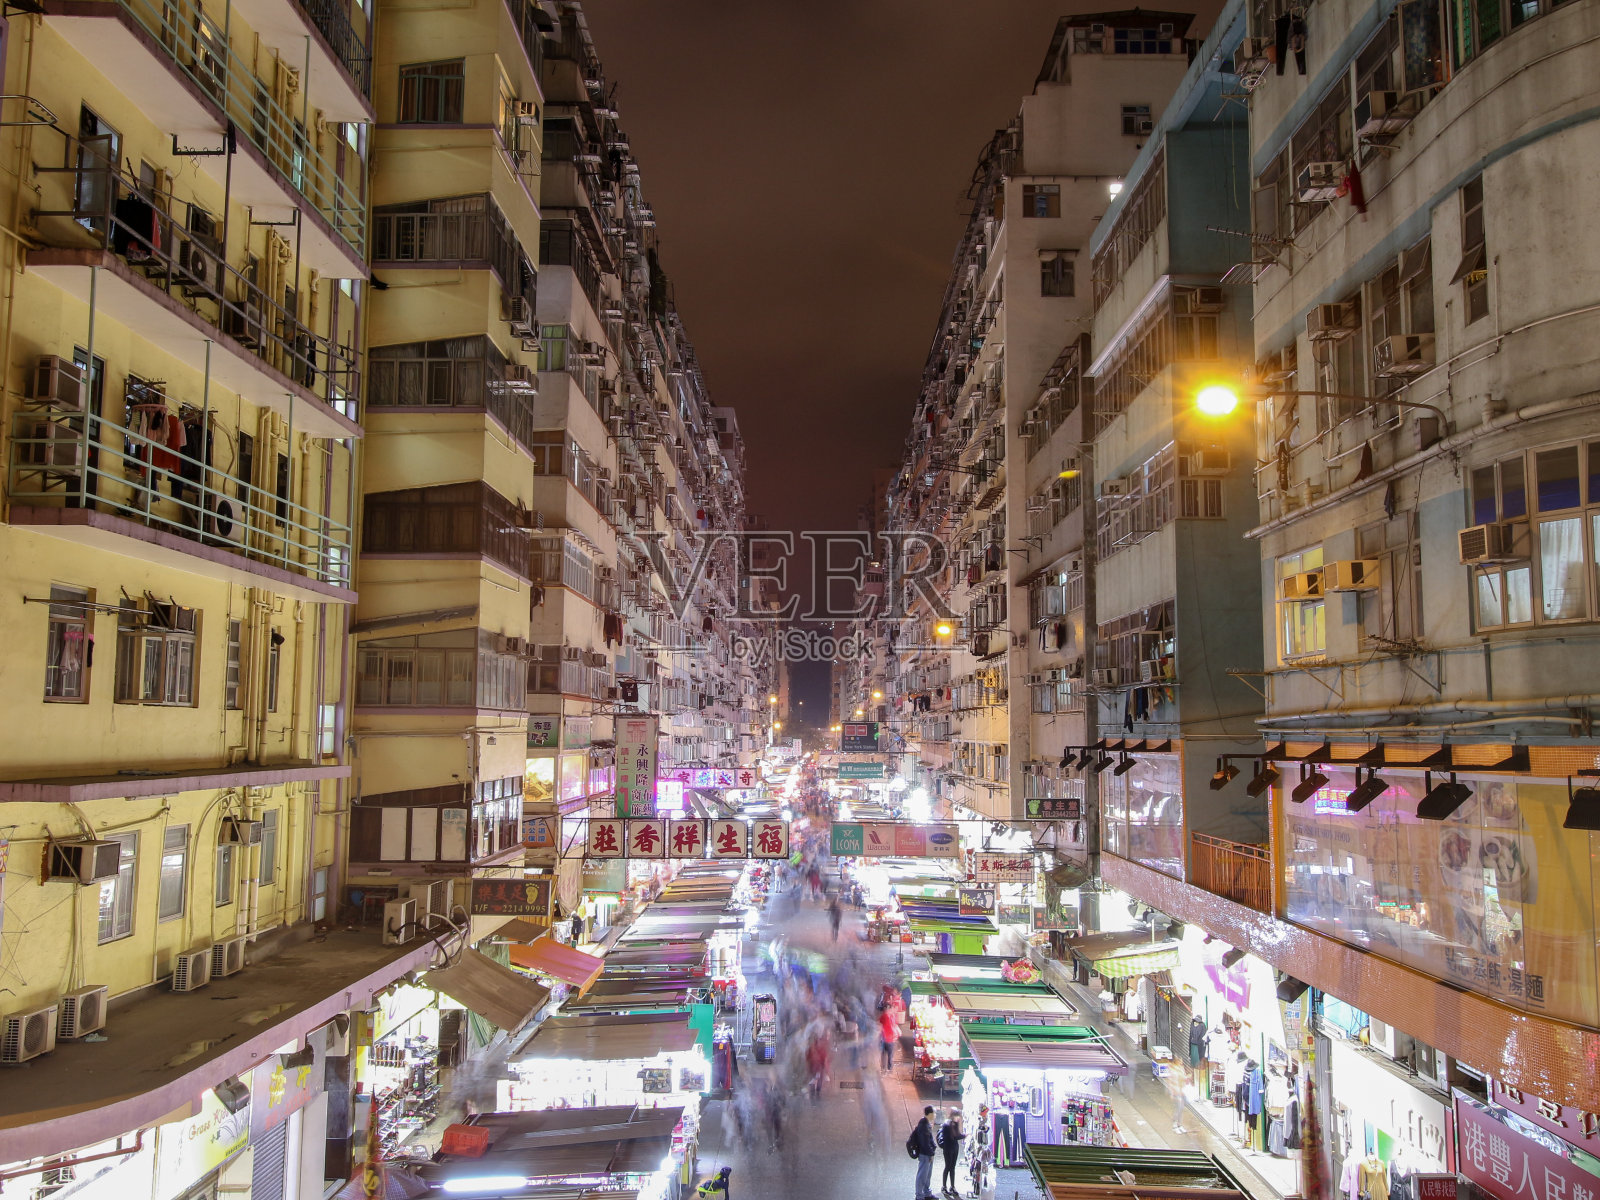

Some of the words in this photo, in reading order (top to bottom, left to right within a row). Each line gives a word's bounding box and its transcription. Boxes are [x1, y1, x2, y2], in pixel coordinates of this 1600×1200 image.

[635, 744, 648, 786] 永興隆
[502, 904, 523, 913] 2214
[525, 905, 546, 913] 9995
